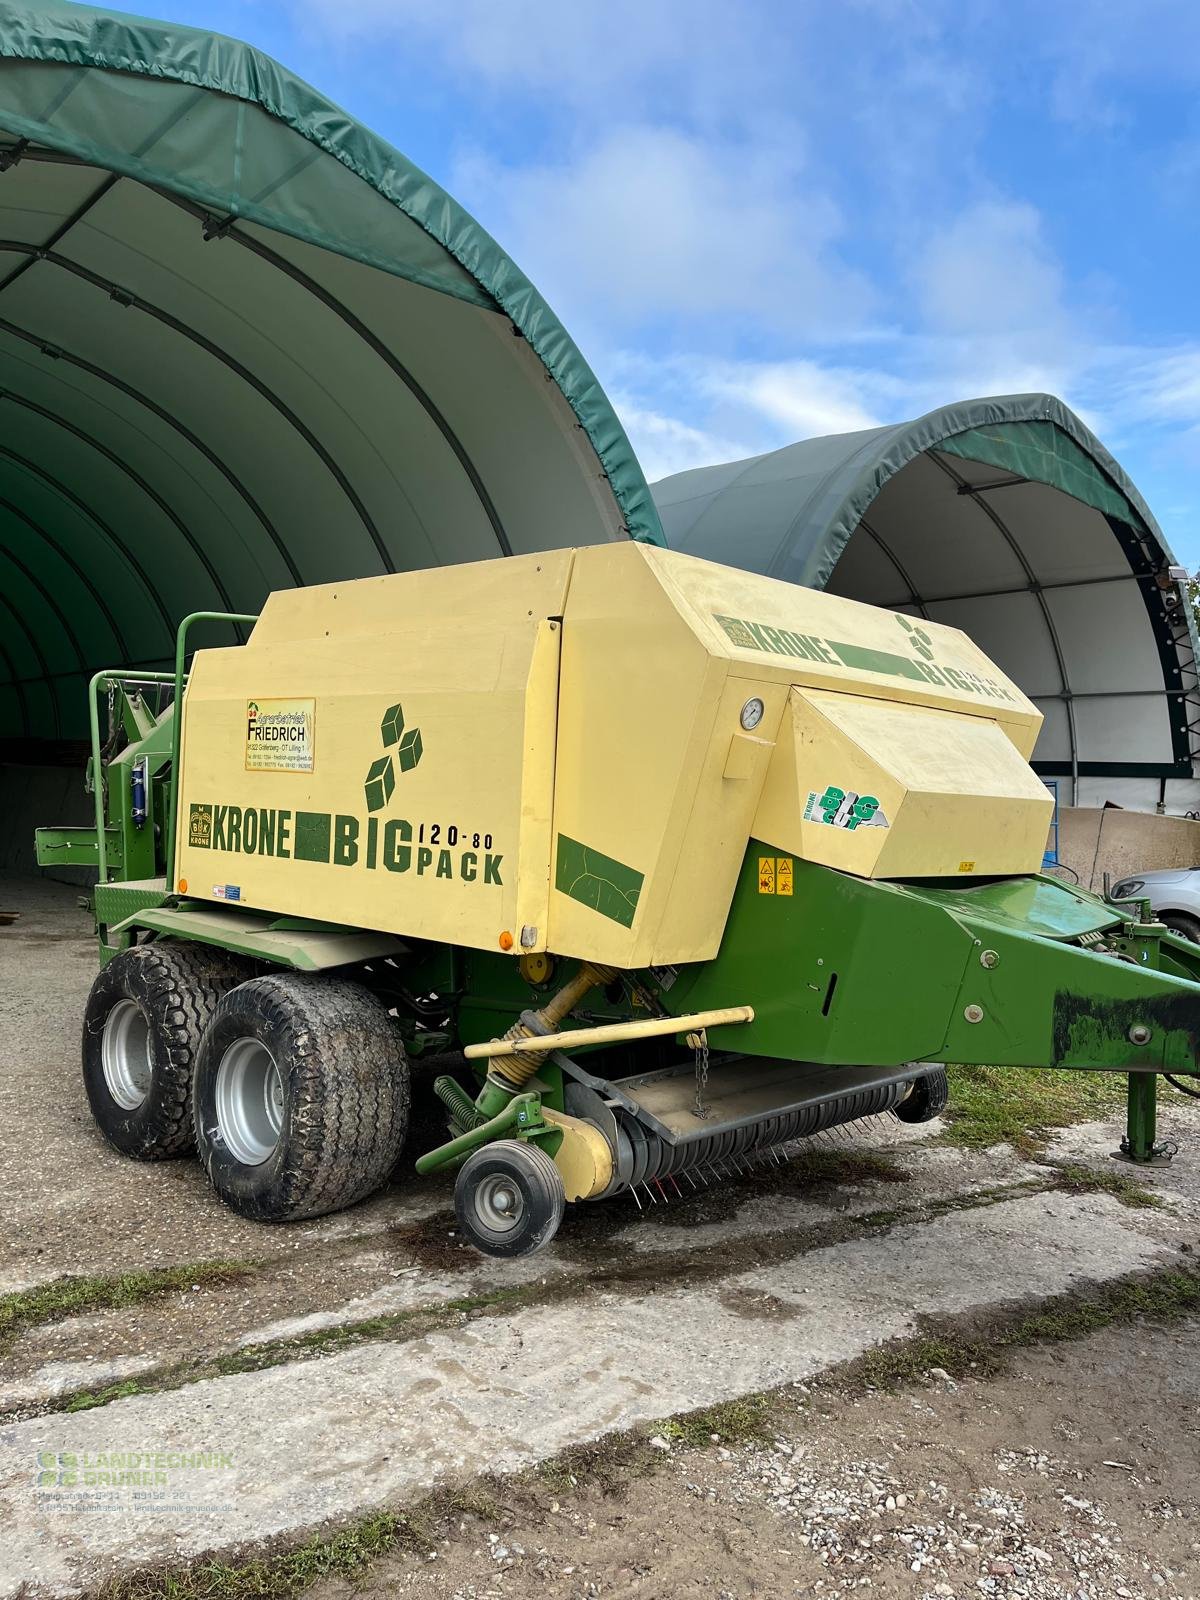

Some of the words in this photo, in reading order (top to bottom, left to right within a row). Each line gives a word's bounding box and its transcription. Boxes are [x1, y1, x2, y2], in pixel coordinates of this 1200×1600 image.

[742, 620, 842, 666] KRONE
[913, 659, 975, 692] BIG
[970, 682, 1016, 702] PACK
[805, 792, 817, 814] KRONE
[819, 786, 880, 819] BIG
[822, 809, 862, 830] CUT
[190, 837, 209, 845] KRONE
[212, 805, 291, 858] KRONE
[333, 814, 413, 873] BIG
[417, 847, 504, 886] PACK
